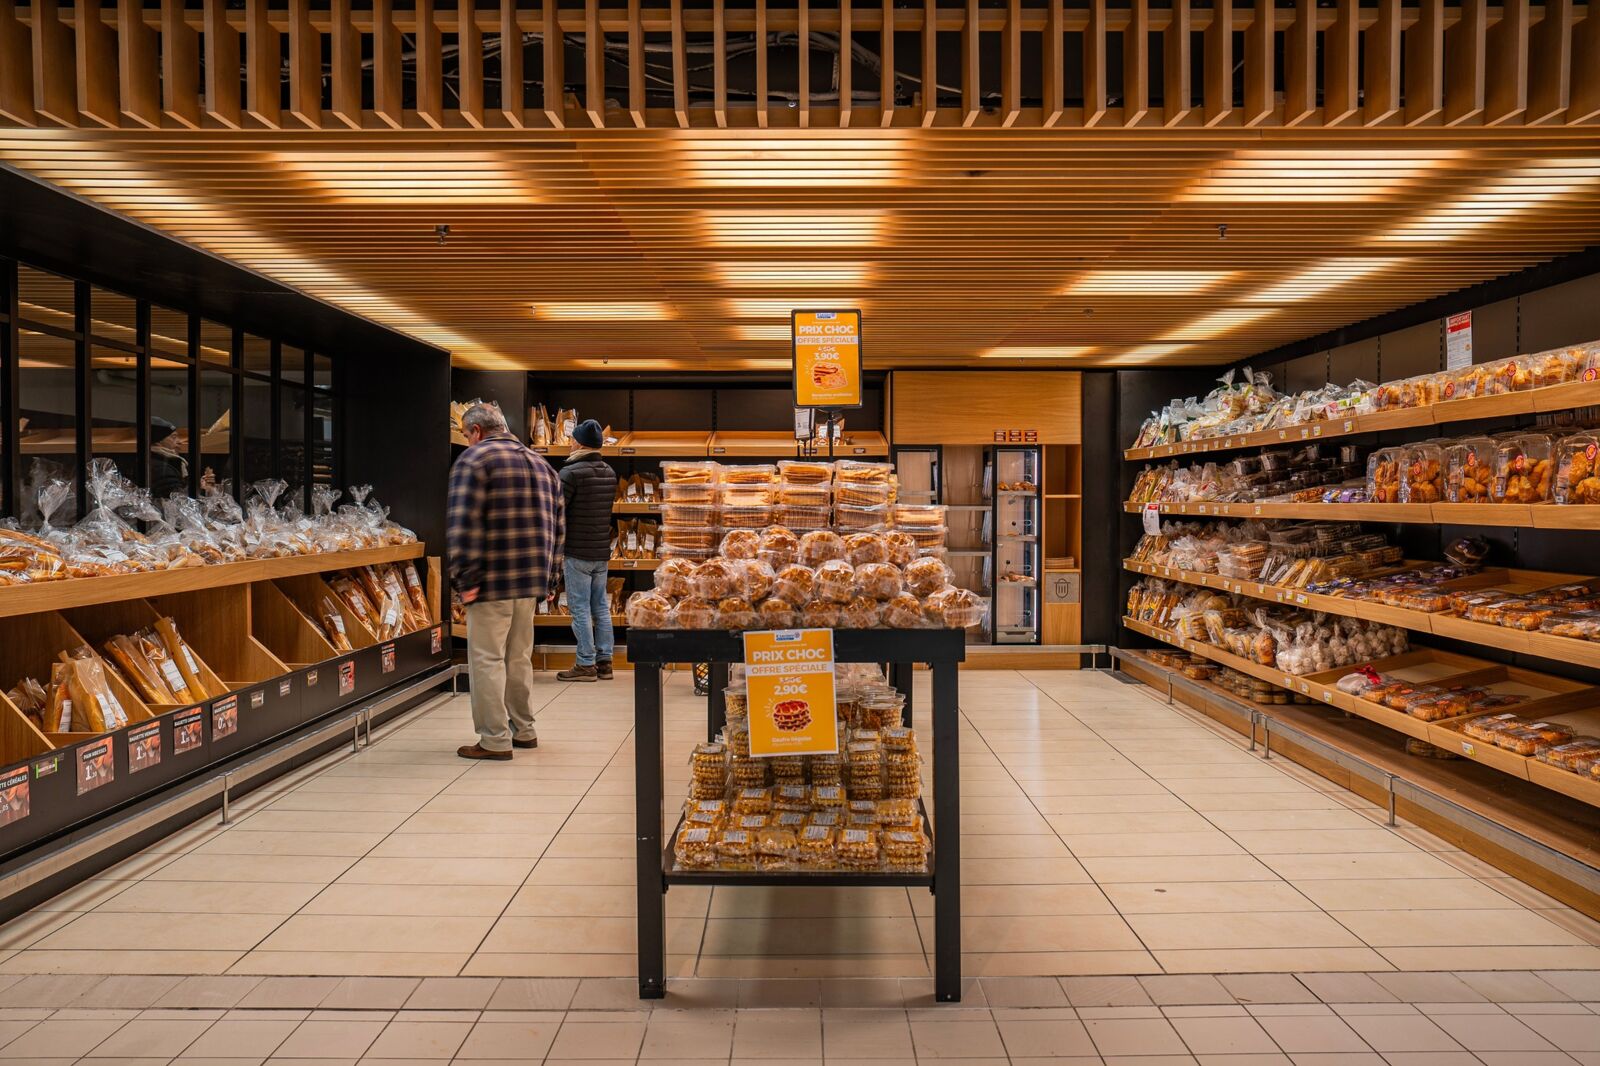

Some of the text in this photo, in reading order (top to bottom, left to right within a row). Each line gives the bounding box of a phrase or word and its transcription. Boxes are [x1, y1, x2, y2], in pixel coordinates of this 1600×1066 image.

[799, 325, 854, 334] PRIX CHOC
[797, 336, 821, 344] OFFRE
[752, 648, 825, 662] PRIX CHOC
[751, 665, 784, 675] OFFRE
